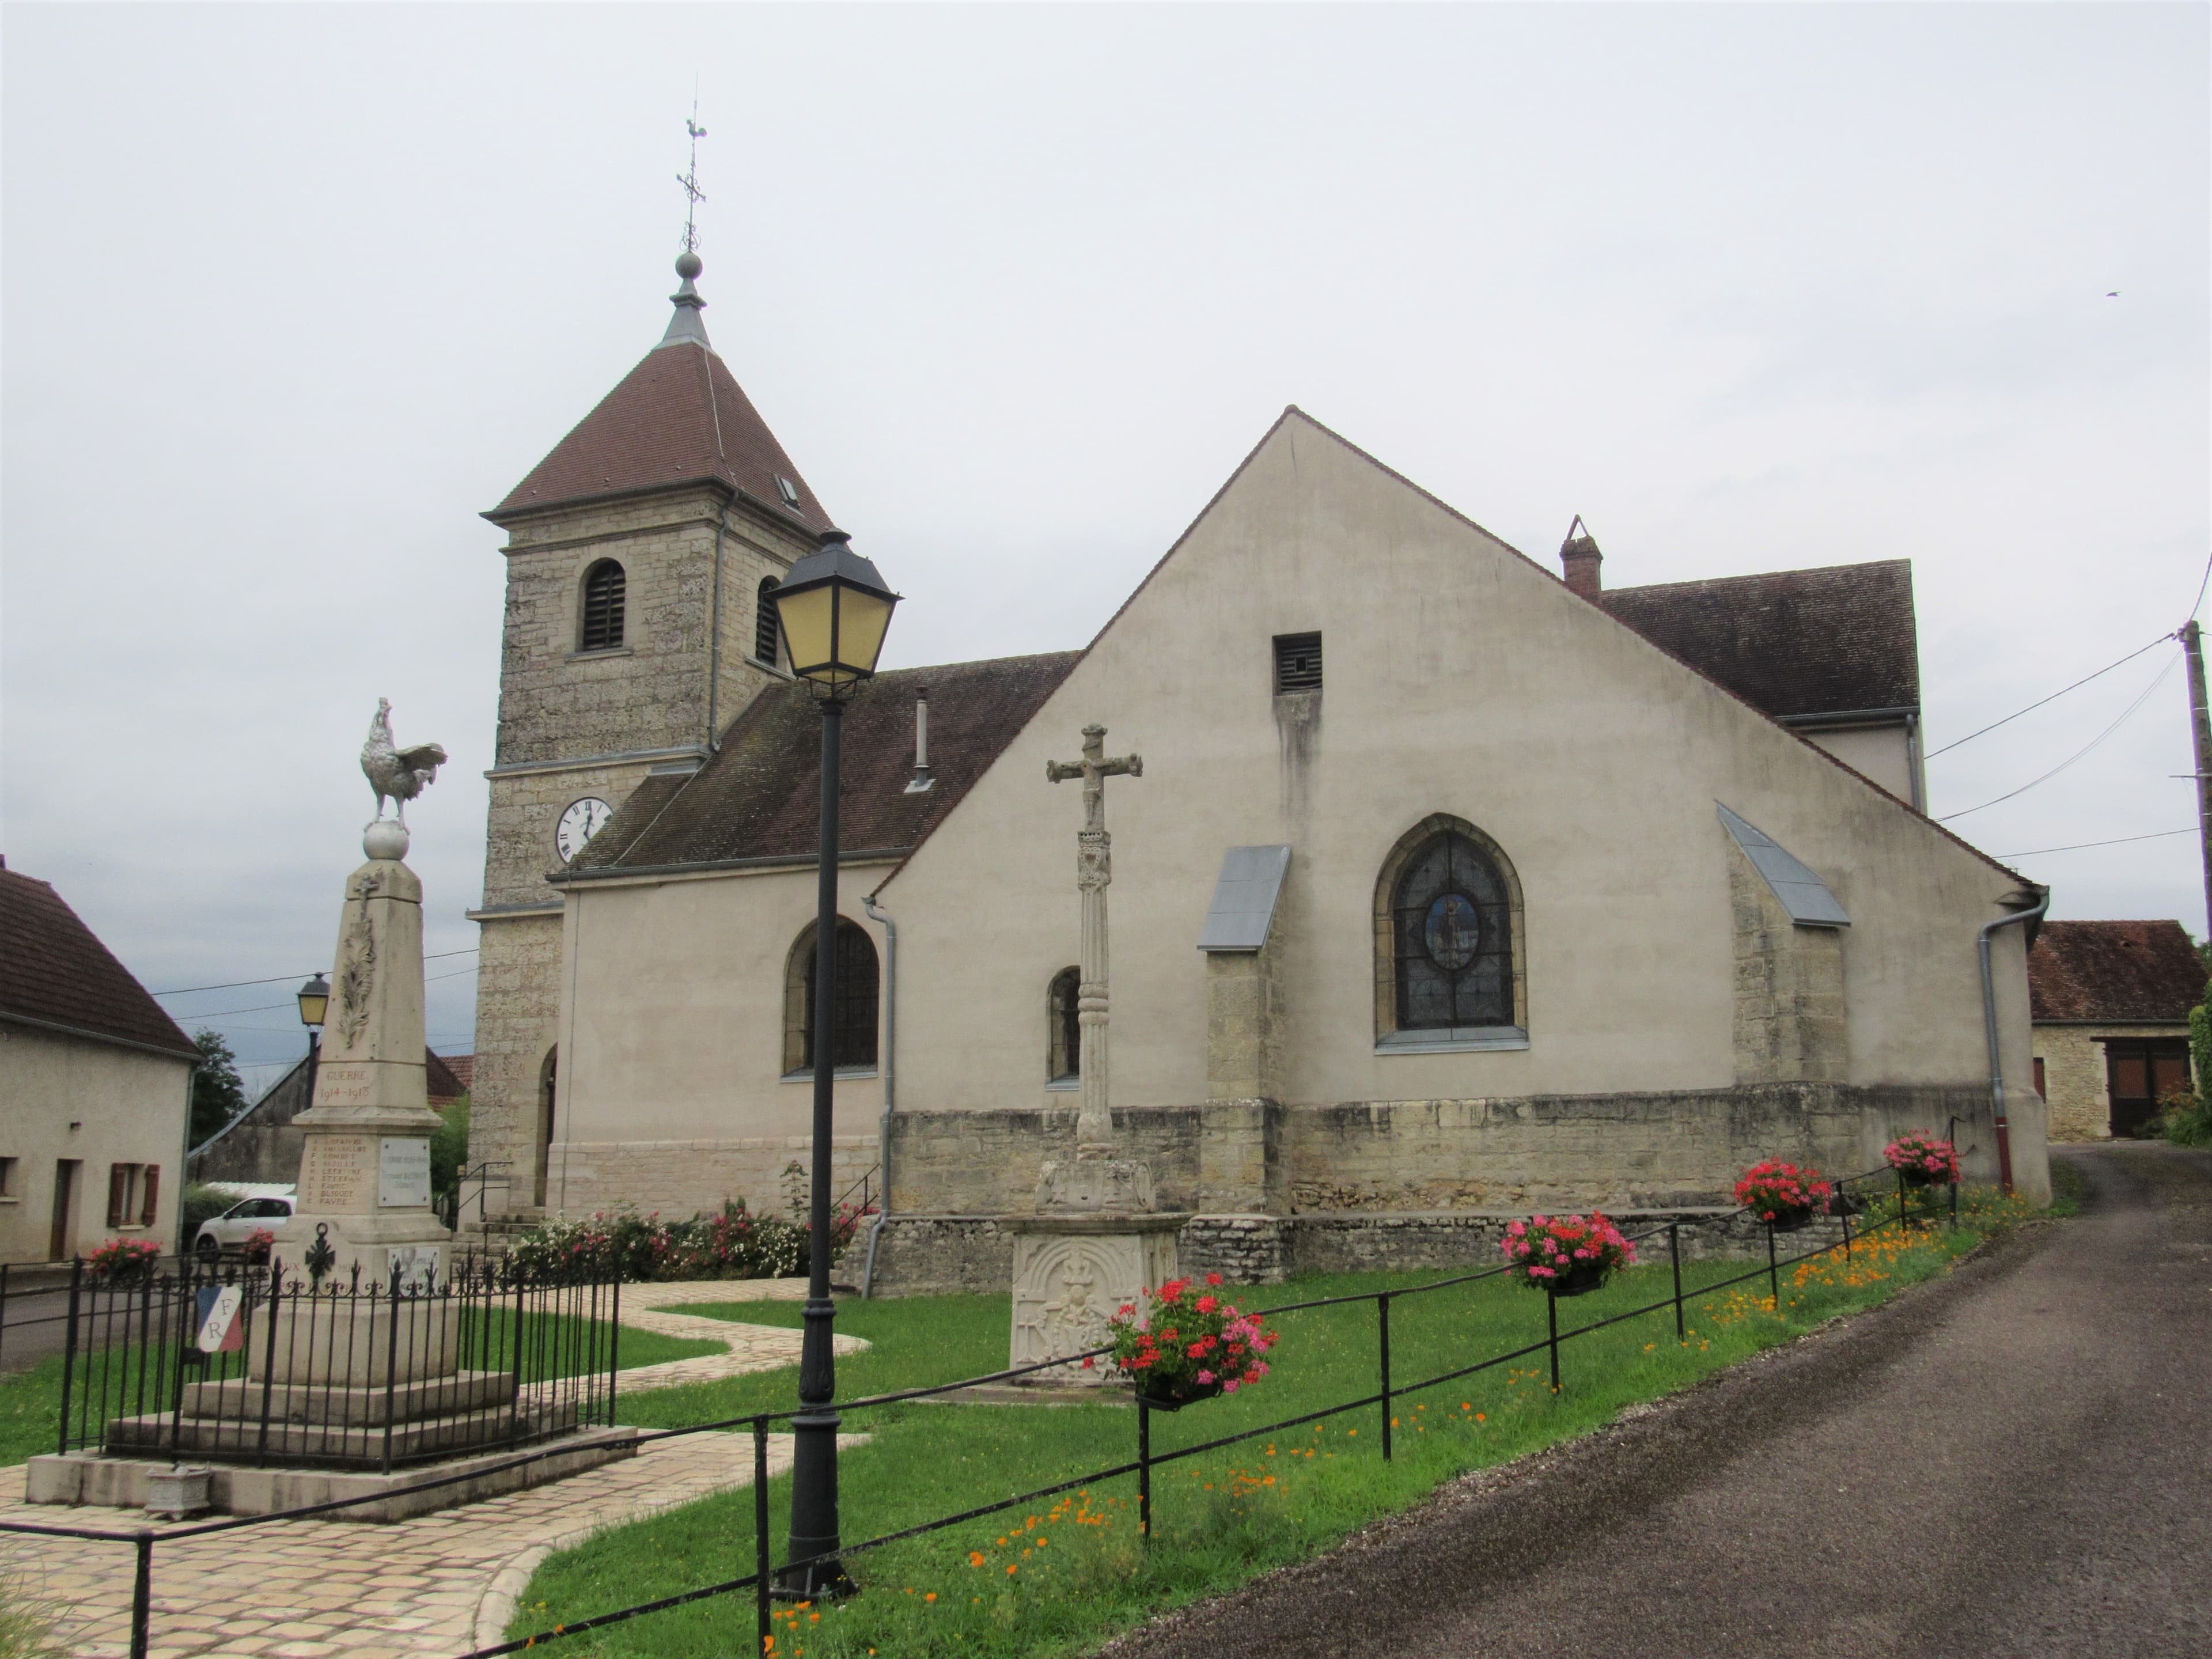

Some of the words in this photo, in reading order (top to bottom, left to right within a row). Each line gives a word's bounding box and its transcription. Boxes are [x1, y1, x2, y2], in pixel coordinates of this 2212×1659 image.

[327, 1070, 366, 1081] GUERRE
[221, 1298, 234, 1316] F
[208, 1322, 224, 1339] R
